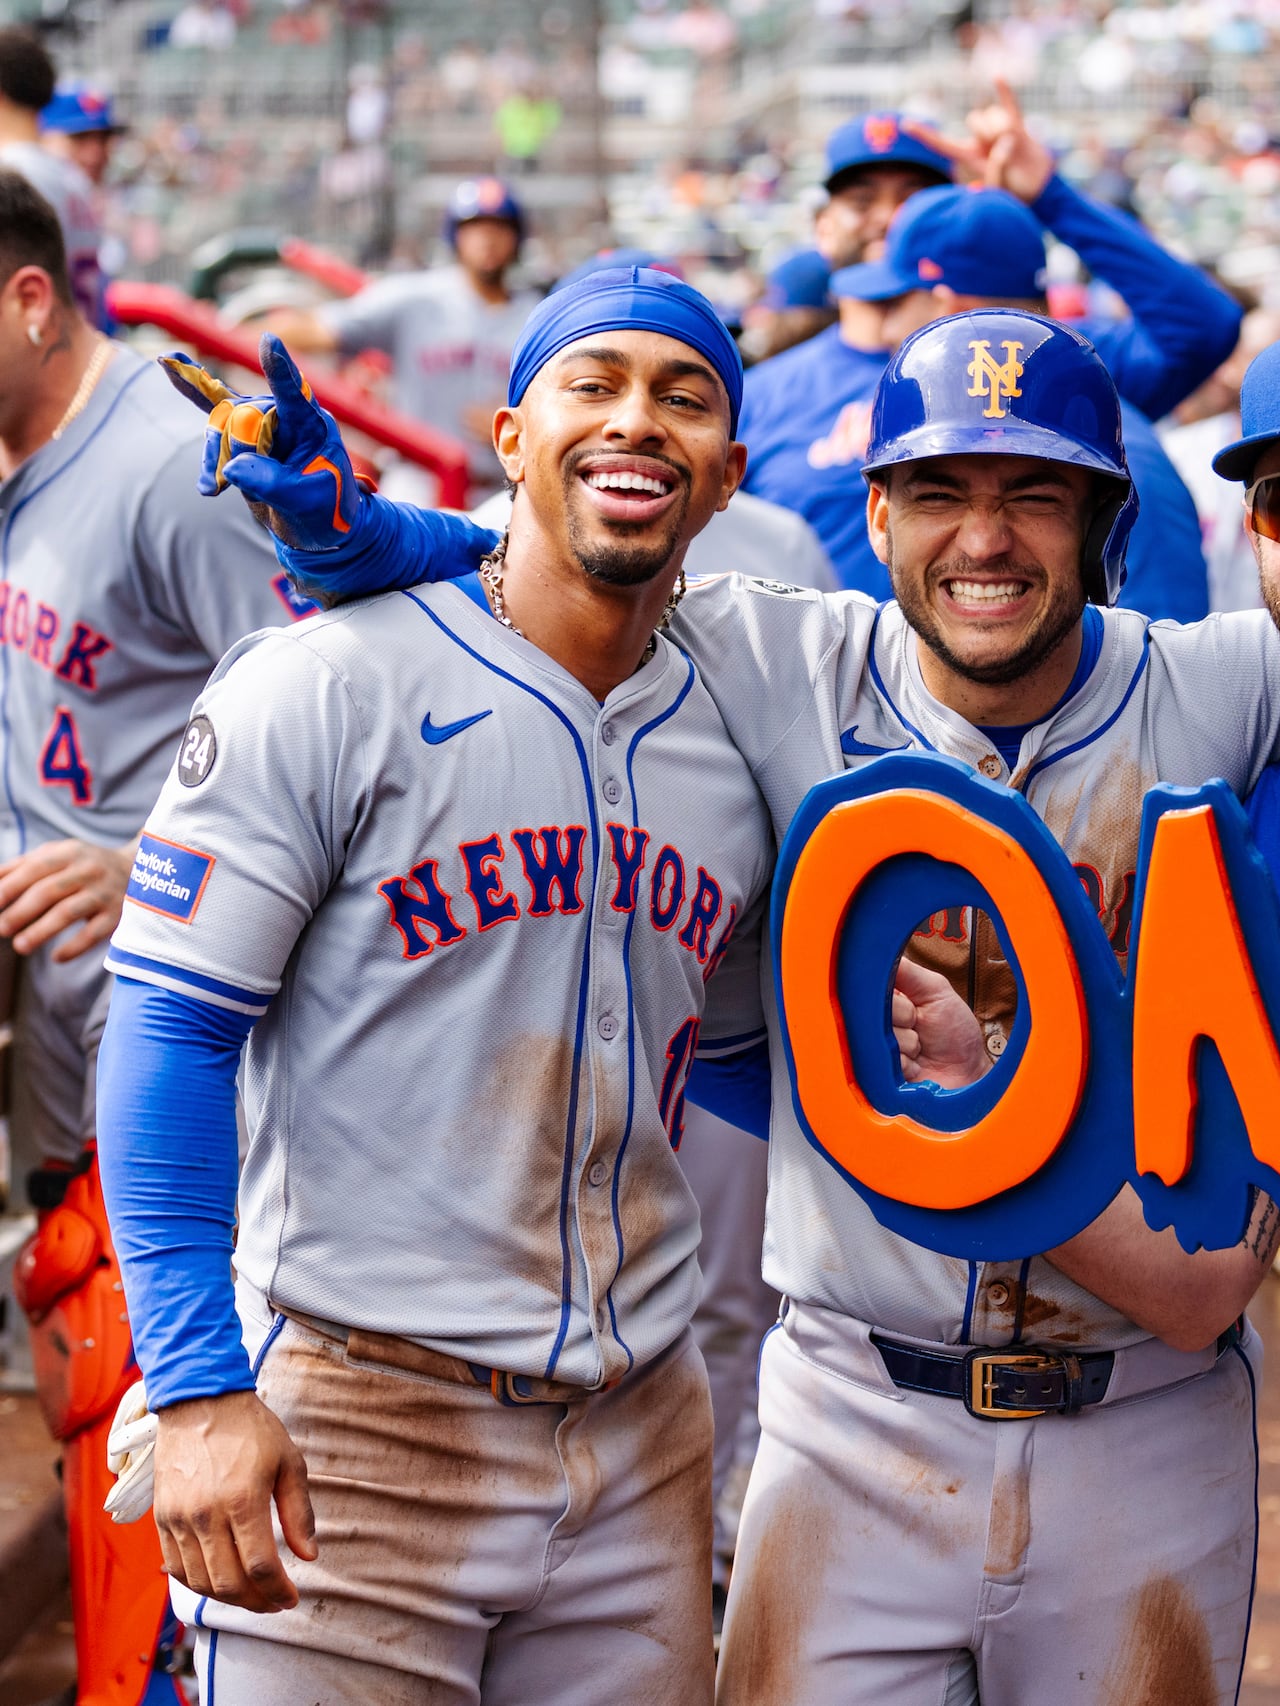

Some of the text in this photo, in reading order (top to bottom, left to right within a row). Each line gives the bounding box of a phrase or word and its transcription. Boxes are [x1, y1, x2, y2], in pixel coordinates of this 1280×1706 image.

[967, 340, 1024, 419] NY
[38, 704, 94, 806] 4
[181, 727, 213, 776] 24
[377, 825, 588, 961] NEW
